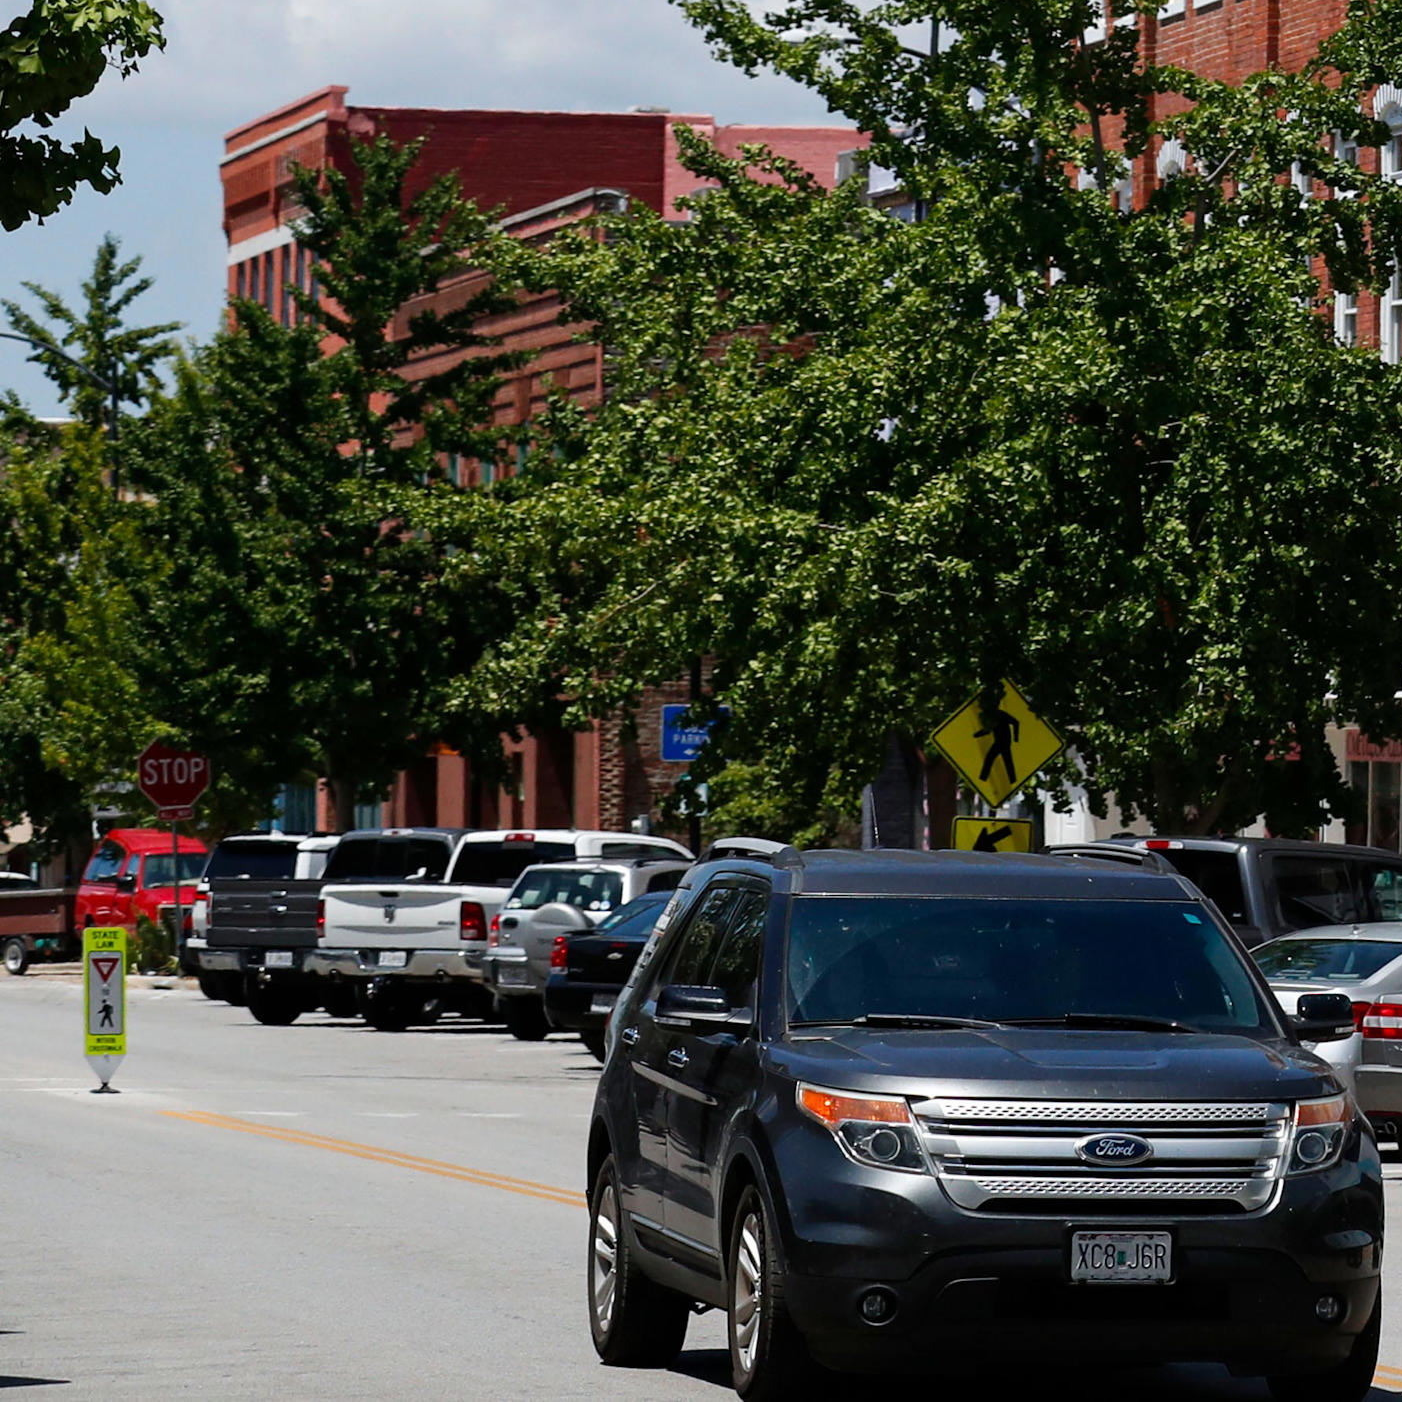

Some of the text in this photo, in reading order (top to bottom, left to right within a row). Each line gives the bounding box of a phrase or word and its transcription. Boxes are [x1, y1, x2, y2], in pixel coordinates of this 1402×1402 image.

[144, 758, 204, 785] STOP
[92, 931, 119, 939] STATE
[1095, 1138, 1135, 1156] Ford
